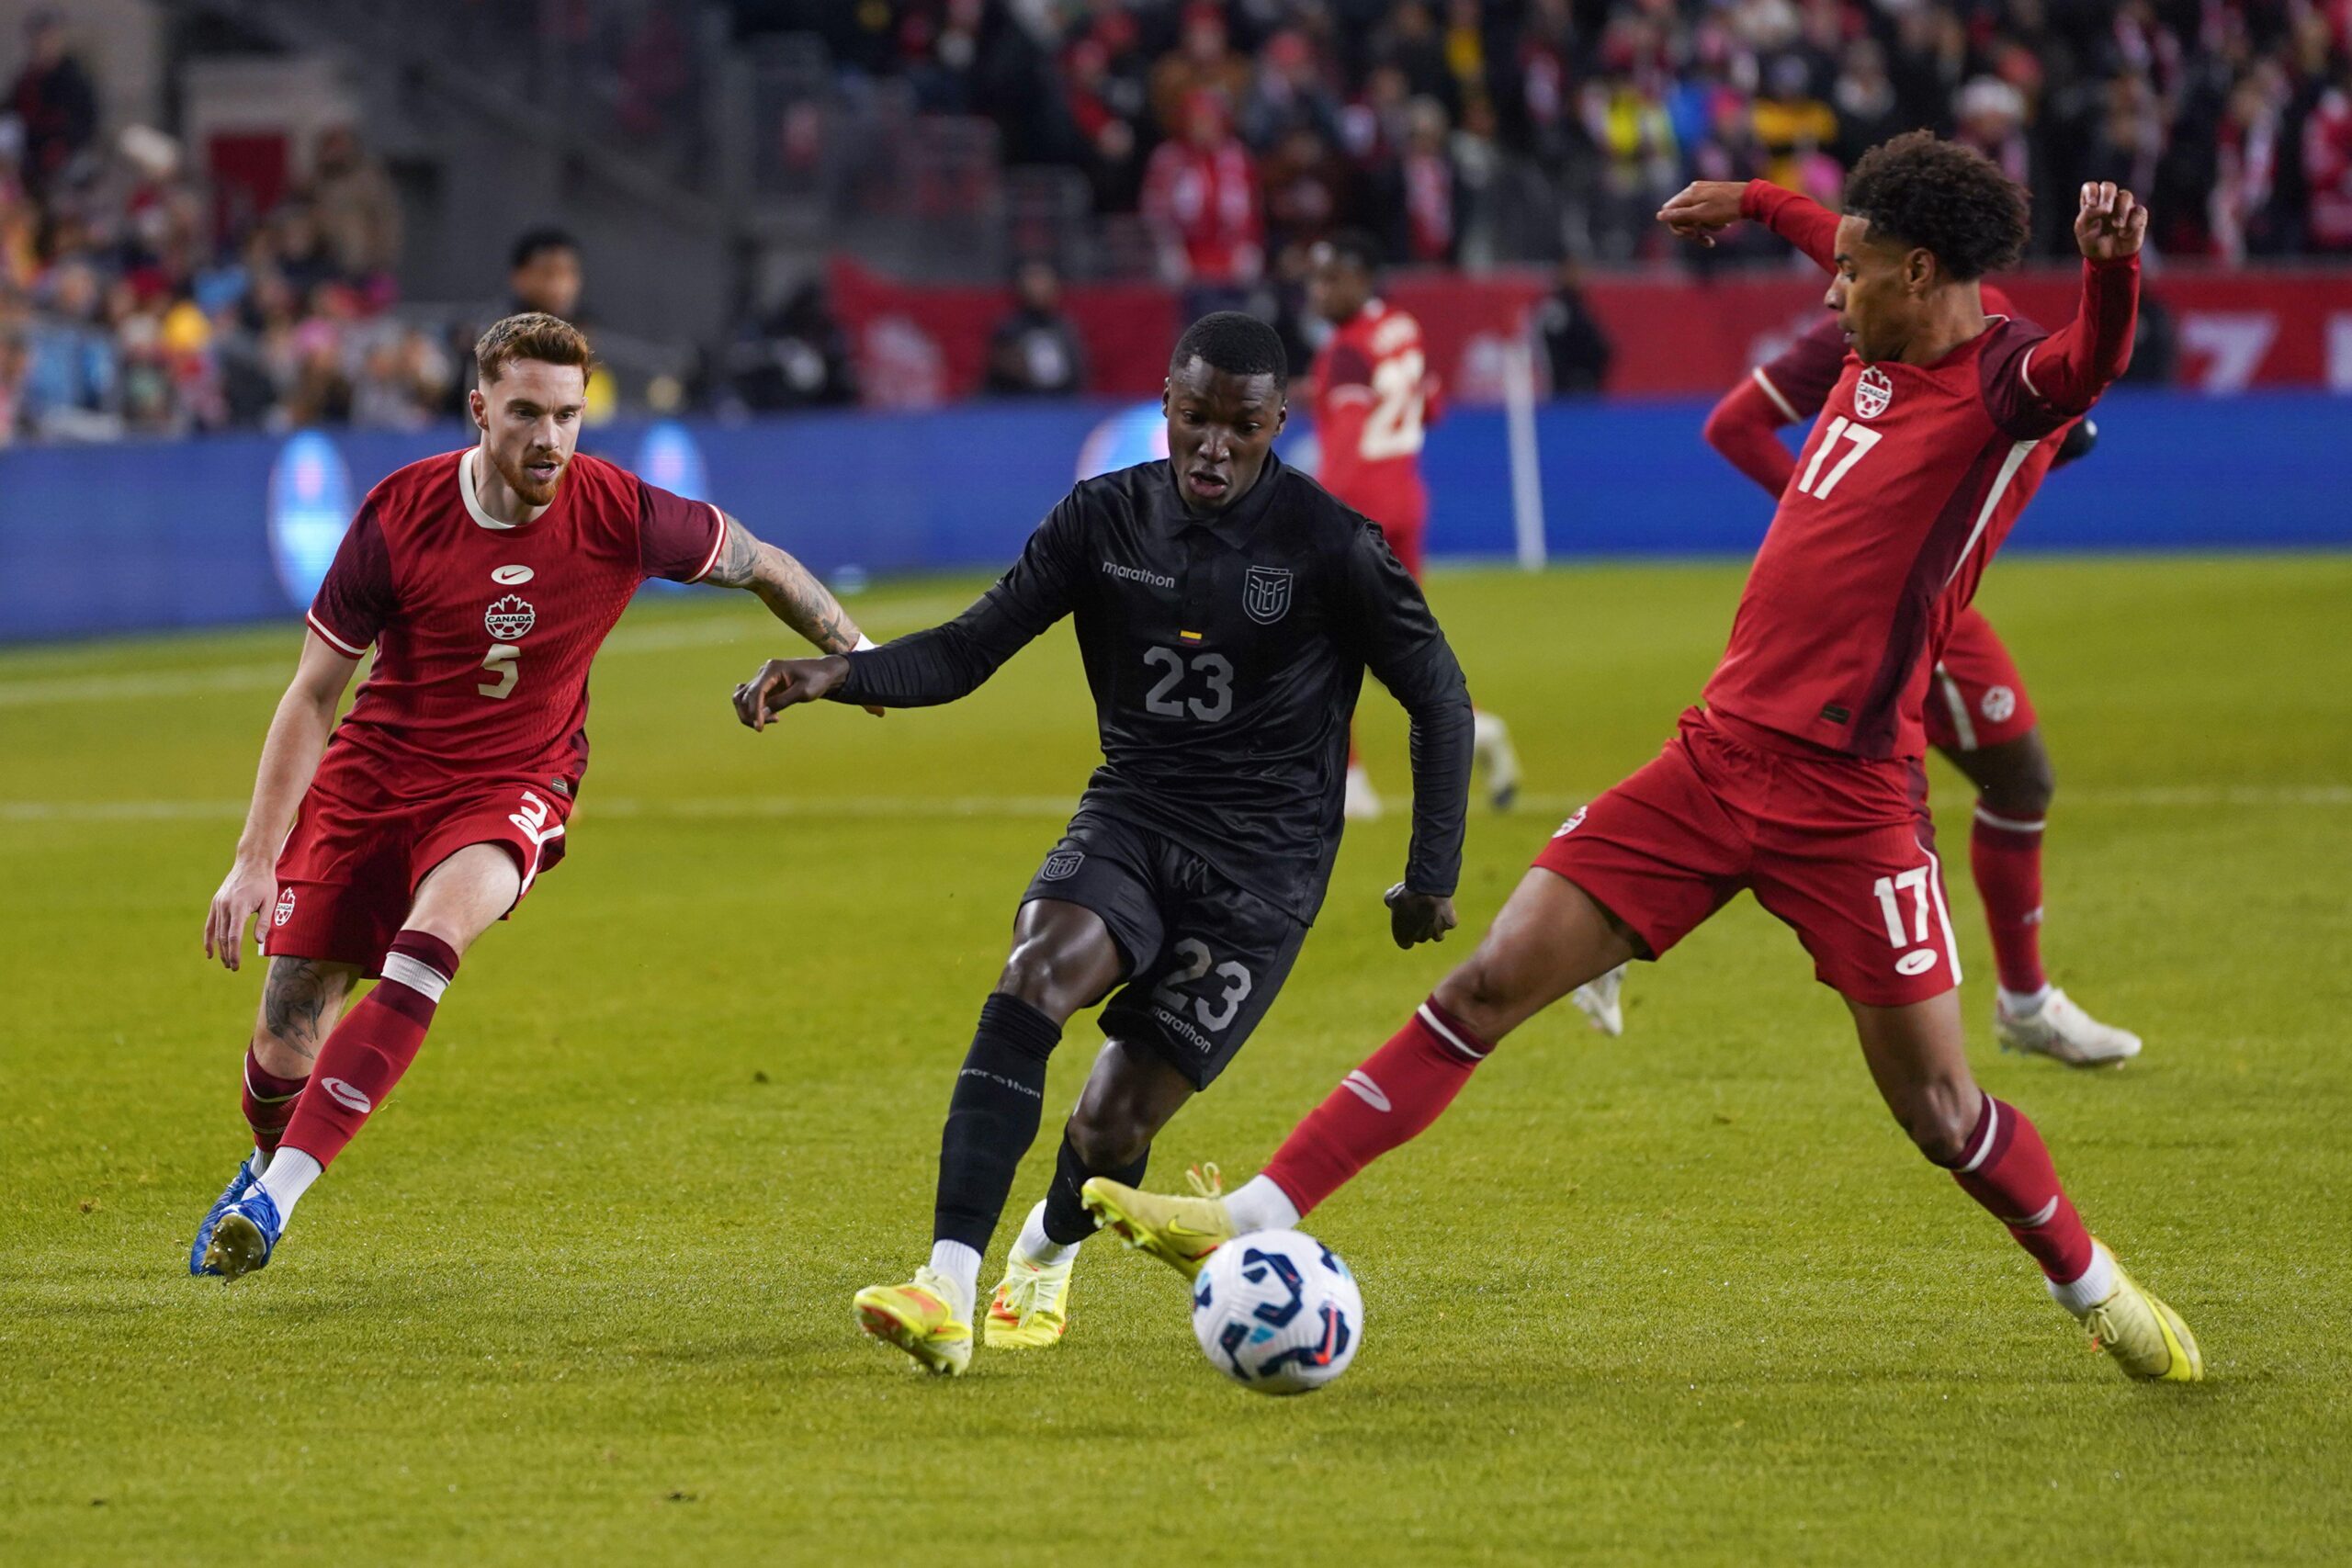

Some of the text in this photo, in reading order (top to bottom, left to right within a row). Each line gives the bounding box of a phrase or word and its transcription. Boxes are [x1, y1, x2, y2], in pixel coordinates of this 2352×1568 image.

[1798, 415, 1883, 500] 17
[1102, 561, 1175, 589] marathon
[478, 643, 522, 699] 5
[1143, 646, 1234, 723] 23
[1873, 865, 1928, 949] 17
[1152, 937, 1253, 1032] 23
